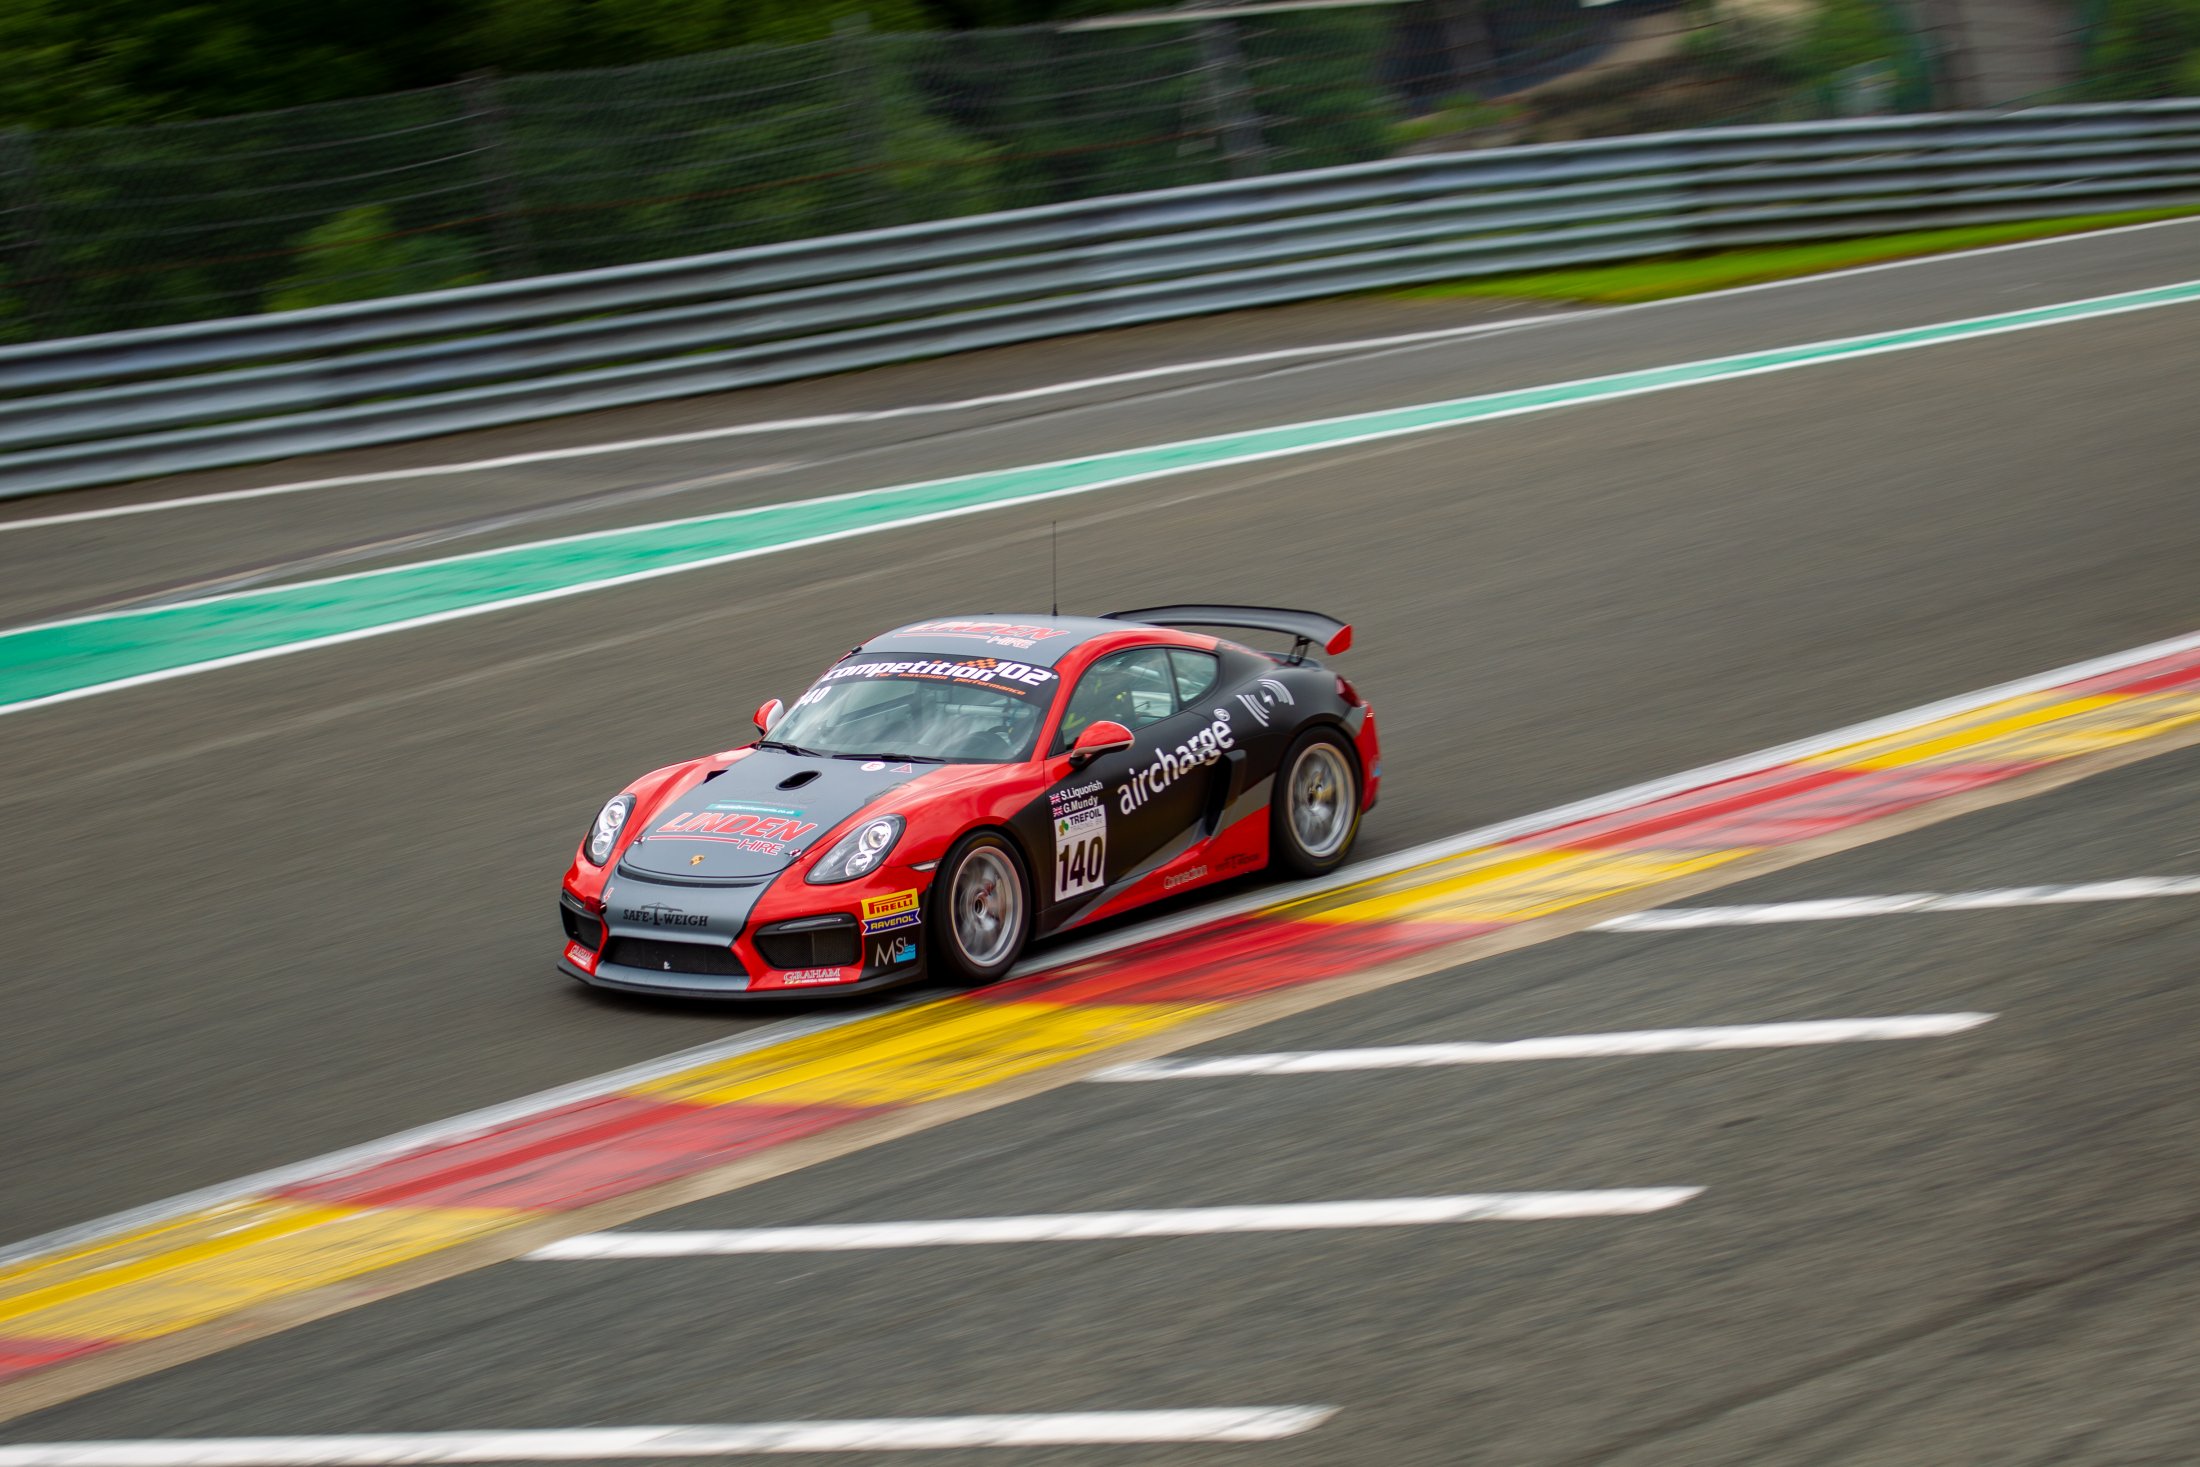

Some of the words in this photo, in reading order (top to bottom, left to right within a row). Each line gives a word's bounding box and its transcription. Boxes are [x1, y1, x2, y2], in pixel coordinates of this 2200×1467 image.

[986, 635, 1037, 649] HIRE
[953, 677, 1026, 695] performance
[1060, 780, 1104, 801] S.Liquorish
[1063, 795, 1099, 813] G.Mundy
[1069, 808, 1102, 825] TREFOIL
[656, 812, 818, 842] LINDEN
[737, 839, 785, 855] HIRE
[1058, 836, 1103, 892] 140
[867, 893, 913, 915] PIRELLI
[870, 915, 914, 930] RAVENOL
[784, 968, 840, 981] GRAHAM
